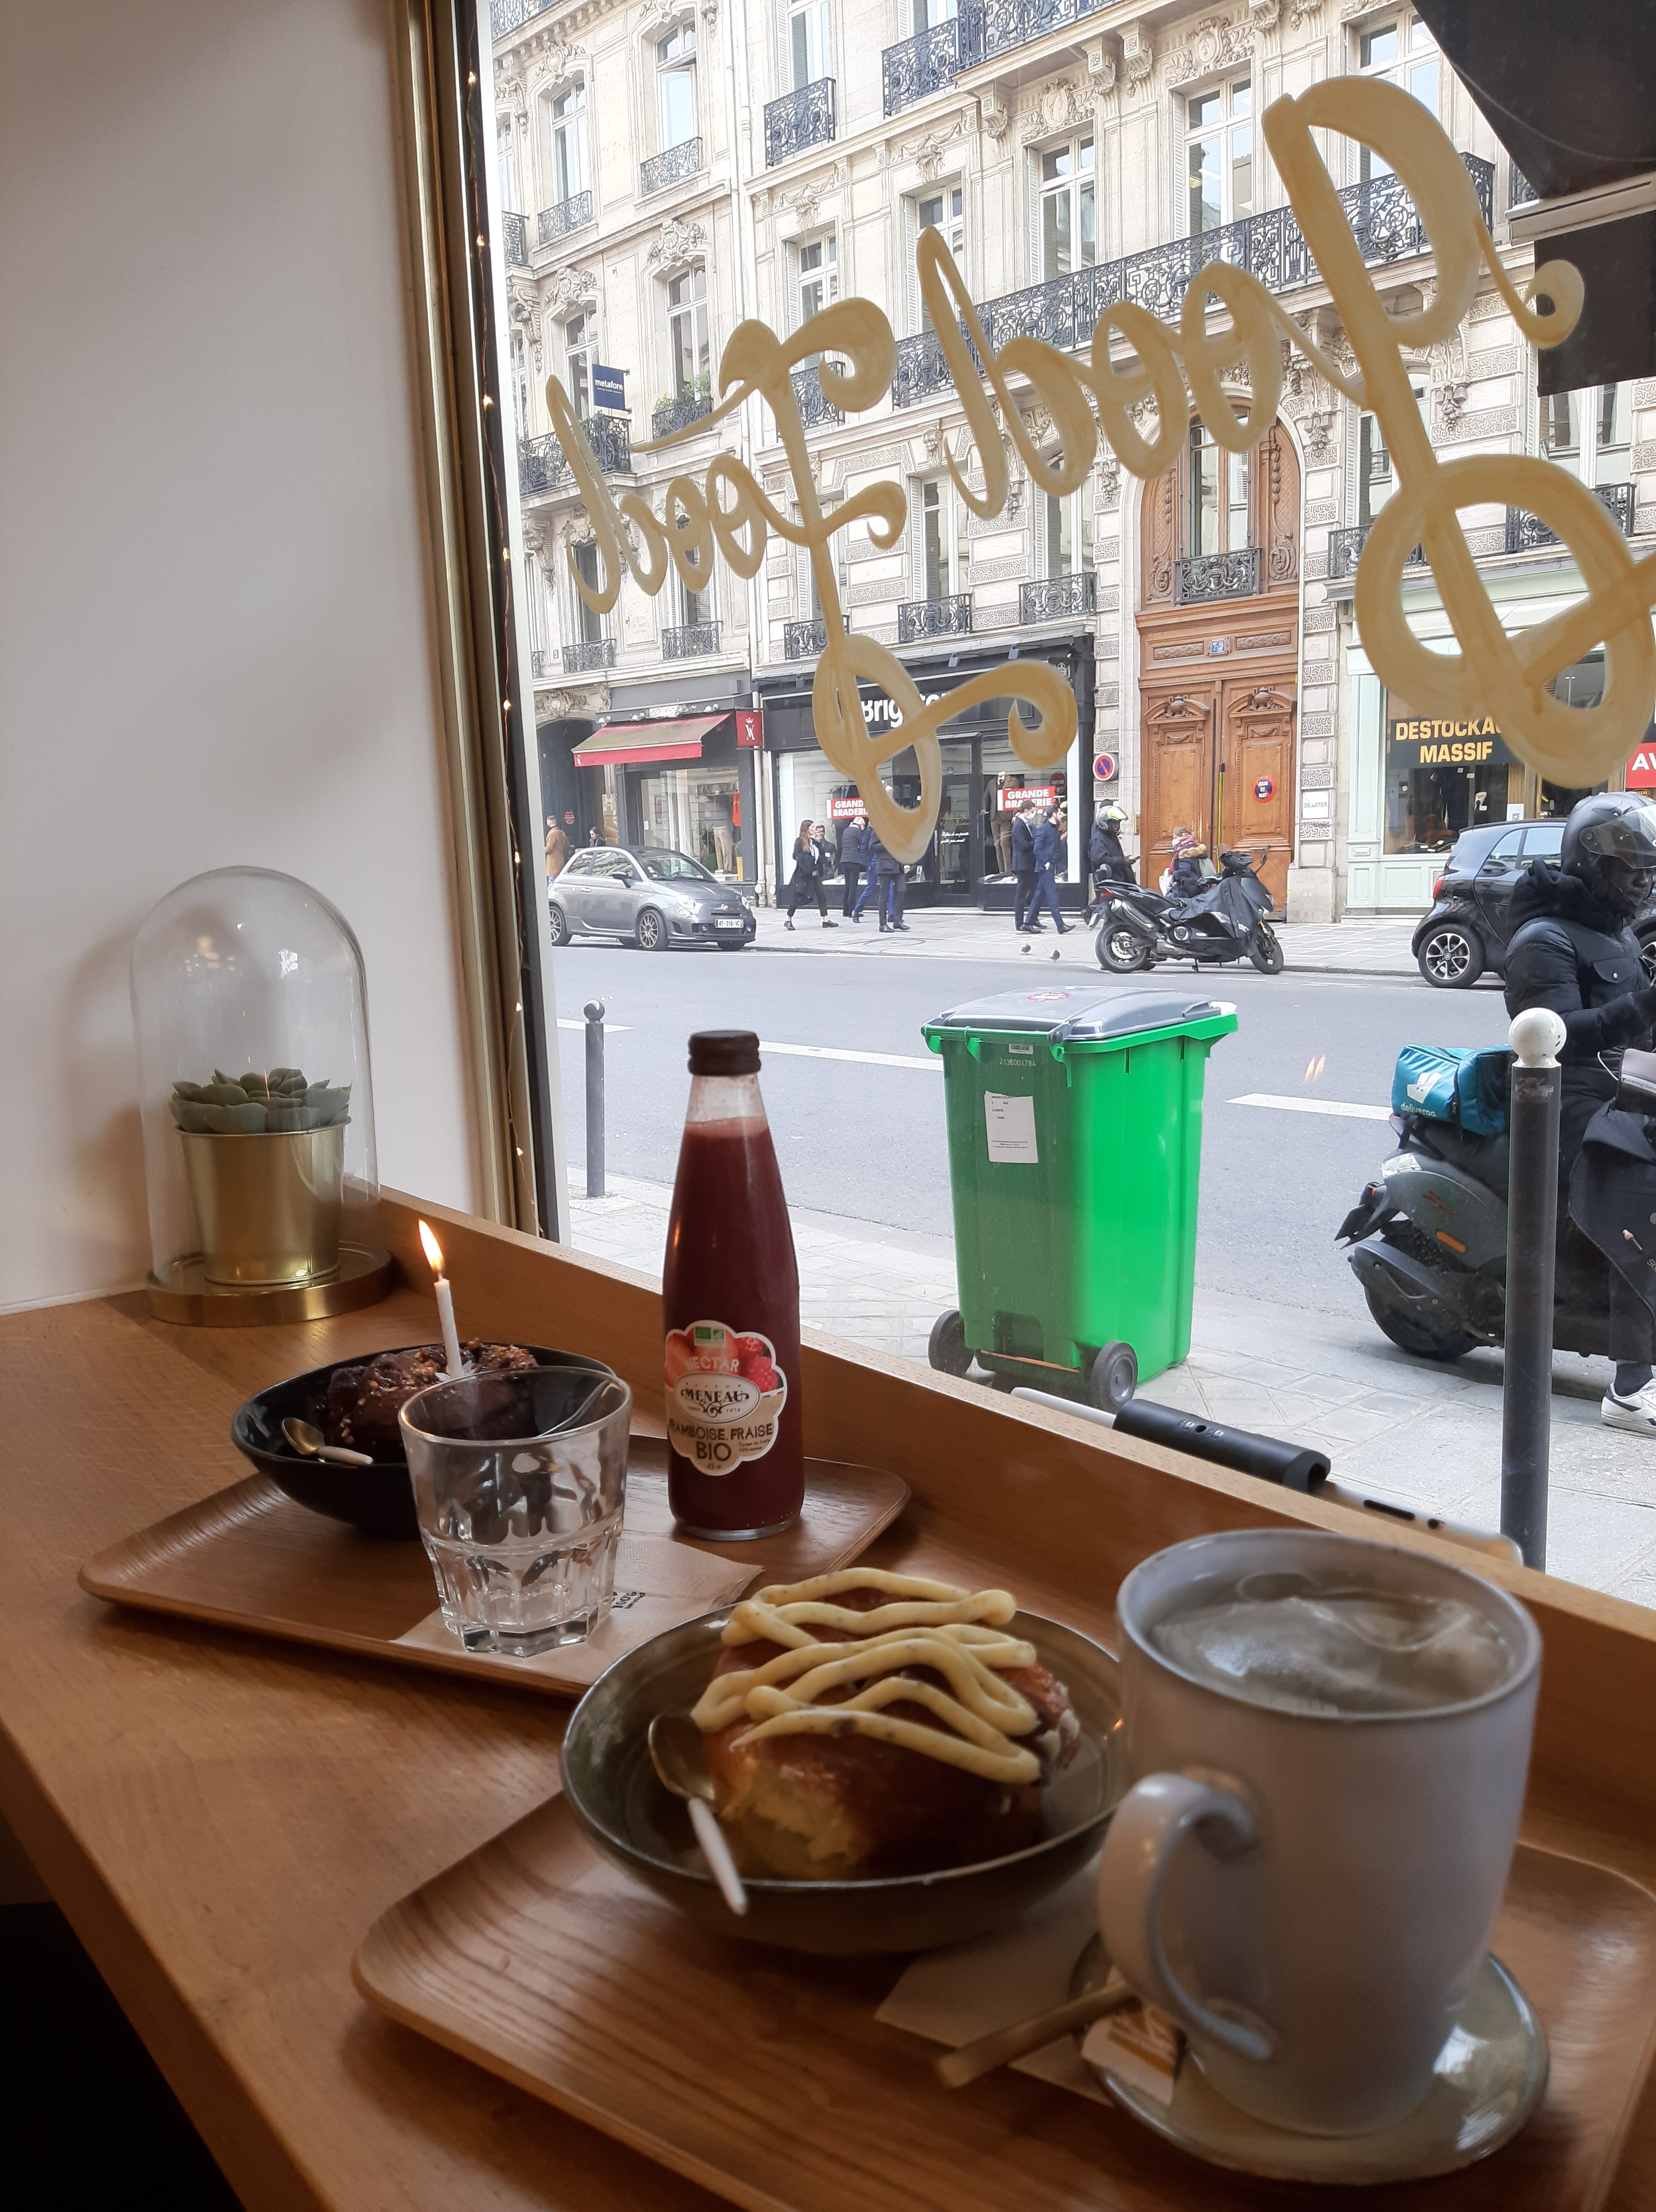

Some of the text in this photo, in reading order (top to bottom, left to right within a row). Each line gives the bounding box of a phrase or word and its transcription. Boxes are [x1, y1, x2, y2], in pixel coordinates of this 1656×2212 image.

[595, 379, 623, 390] metafore
[1213, 642, 1223, 651] 7-9
[1396, 716, 1501, 740] DESTOCKA
[1420, 741, 1493, 763] MASSIF
[1007, 789, 1049, 799] GRANDE
[835, 800, 864, 808] GRAND
[1005, 798, 1052, 808] BRAERIE
[1400, 1101, 1436, 1117] deliveroo
[684, 1356, 740, 1373] NECTAR
[731, 1422, 773, 1440] FRAISE
[696, 1441, 732, 1461] BIO
